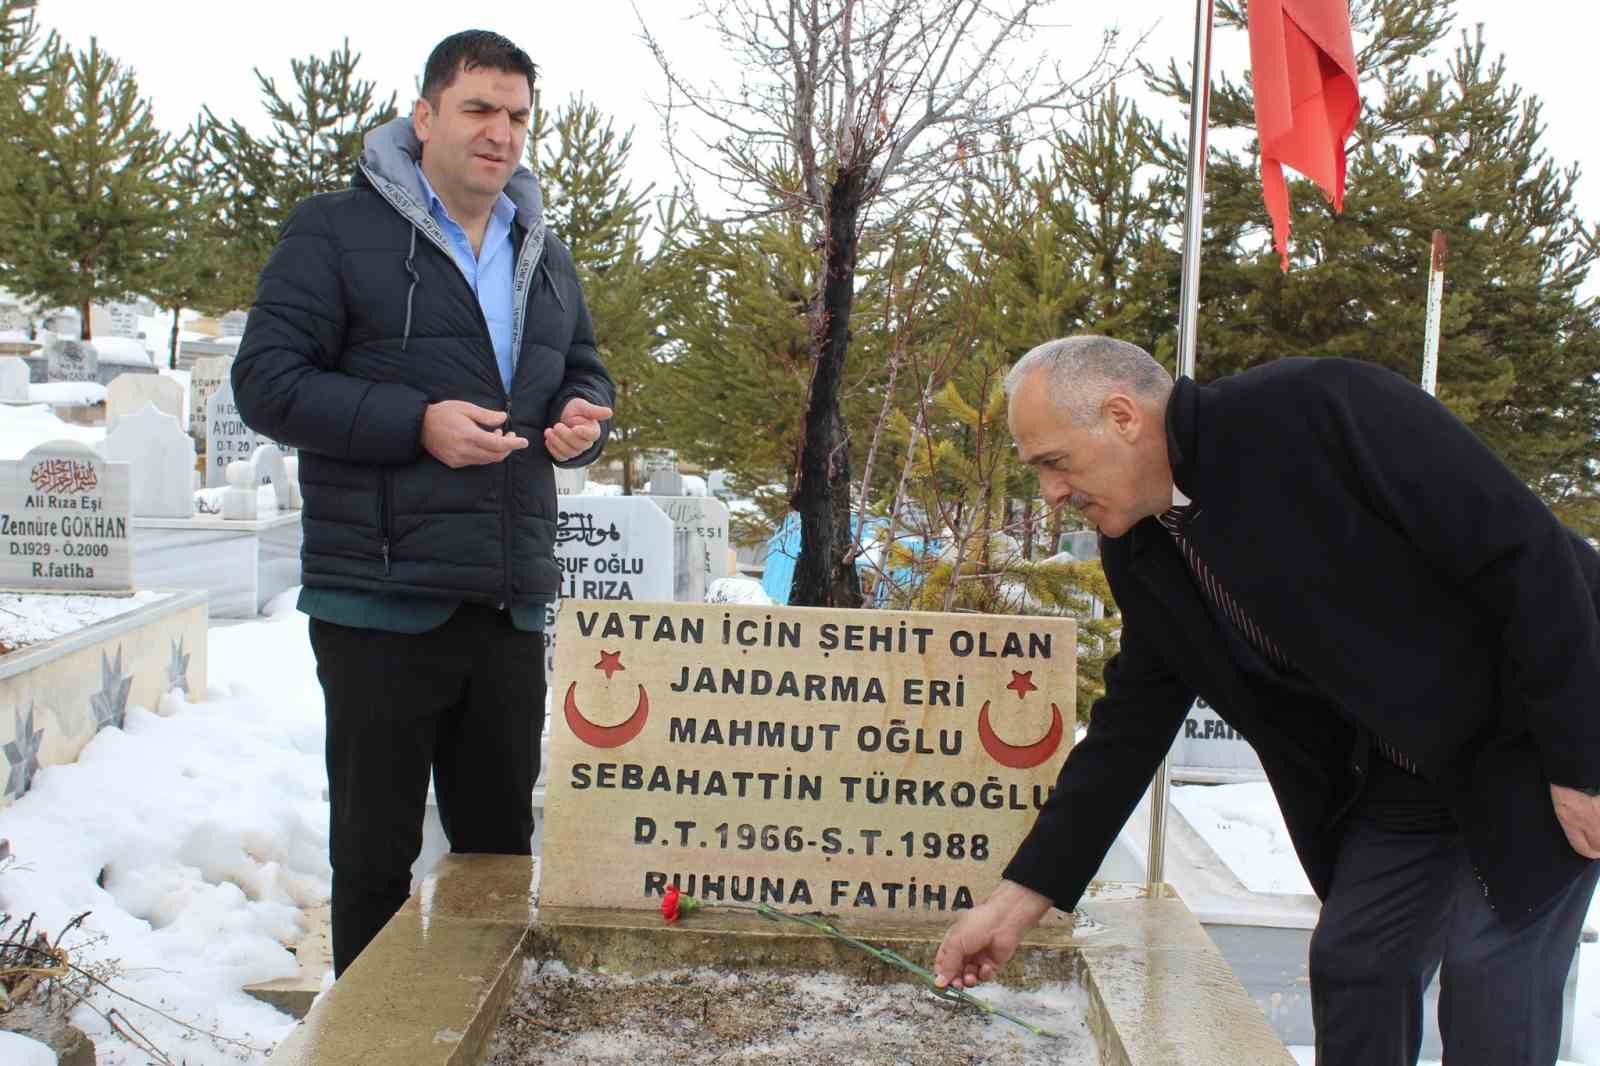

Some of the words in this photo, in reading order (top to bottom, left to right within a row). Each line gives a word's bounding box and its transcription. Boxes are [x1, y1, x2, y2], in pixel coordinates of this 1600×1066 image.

[25, 495, 44, 508] Ali
[9, 541, 51, 556] D.1929
[556, 556, 589, 574] SUF
[594, 553, 644, 574] OĞLU
[31, 562, 95, 578] R.fatiha
[557, 575, 576, 599] Lİ
[583, 580, 634, 601] RIZA
[576, 611, 704, 644] VATAN
[722, 612, 801, 654] İÇİN
[818, 620, 934, 658] ŞEHİT
[949, 629, 1052, 659] OLAN
[670, 666, 886, 704] JANDARMA
[903, 674, 965, 707] ERİ
[668, 717, 841, 753] MAHMUT
[857, 718, 963, 756] OĞLU
[570, 762, 822, 801] SEBAHATTİN
[839, 771, 1055, 810] TÜRKOĞLU
[644, 871, 813, 905] RUHUNA
[830, 876, 976, 912] FATİHA
